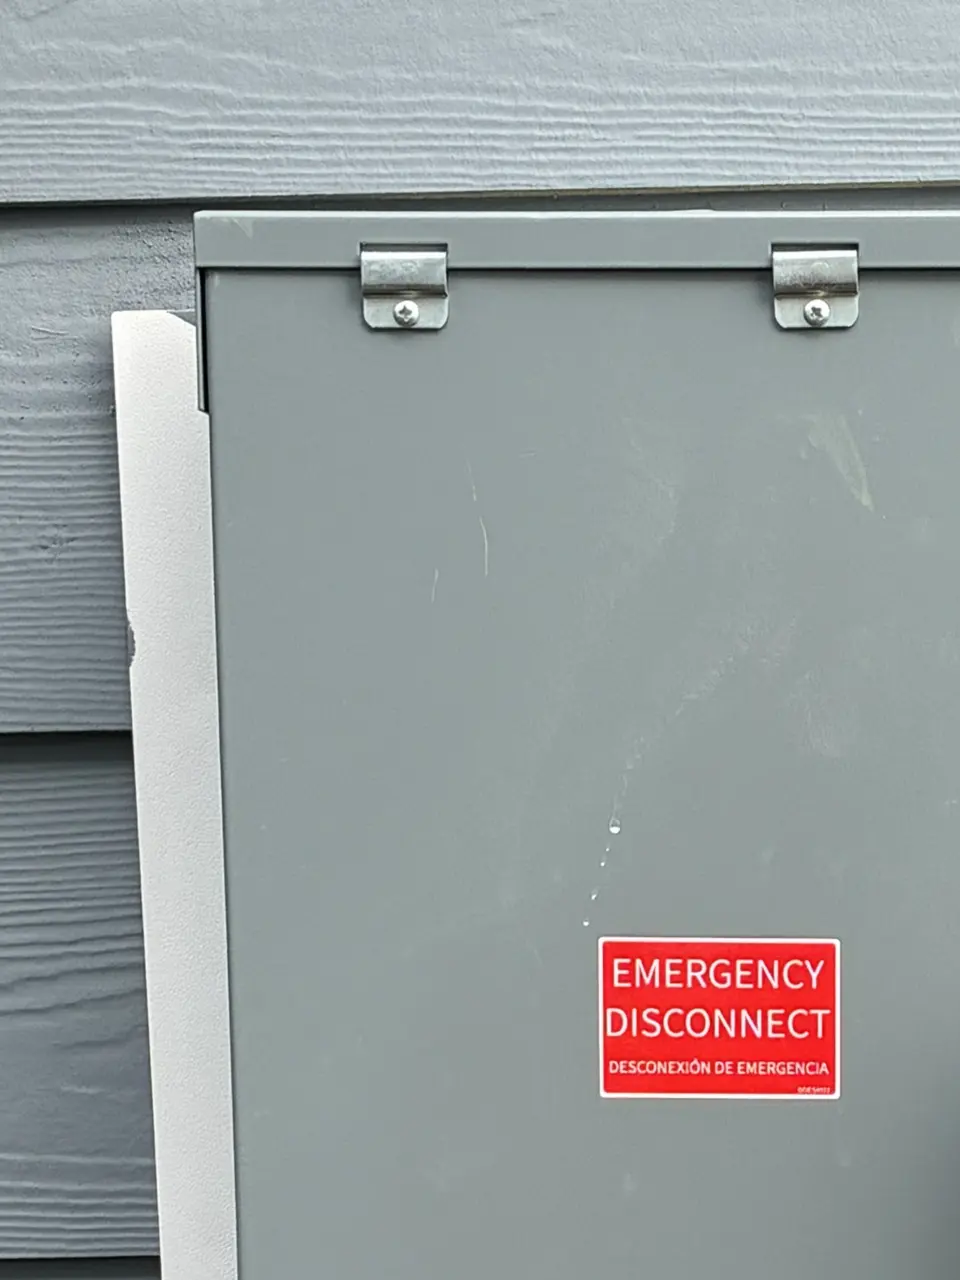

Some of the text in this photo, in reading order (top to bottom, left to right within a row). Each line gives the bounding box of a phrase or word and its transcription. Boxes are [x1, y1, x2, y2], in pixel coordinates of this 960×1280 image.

[613, 957, 824, 989] EMERGENCY
[606, 1007, 830, 1039] DISCONNECT
[608, 1058, 830, 1076] DESCONEXIÓN DE EMERGENCIA
